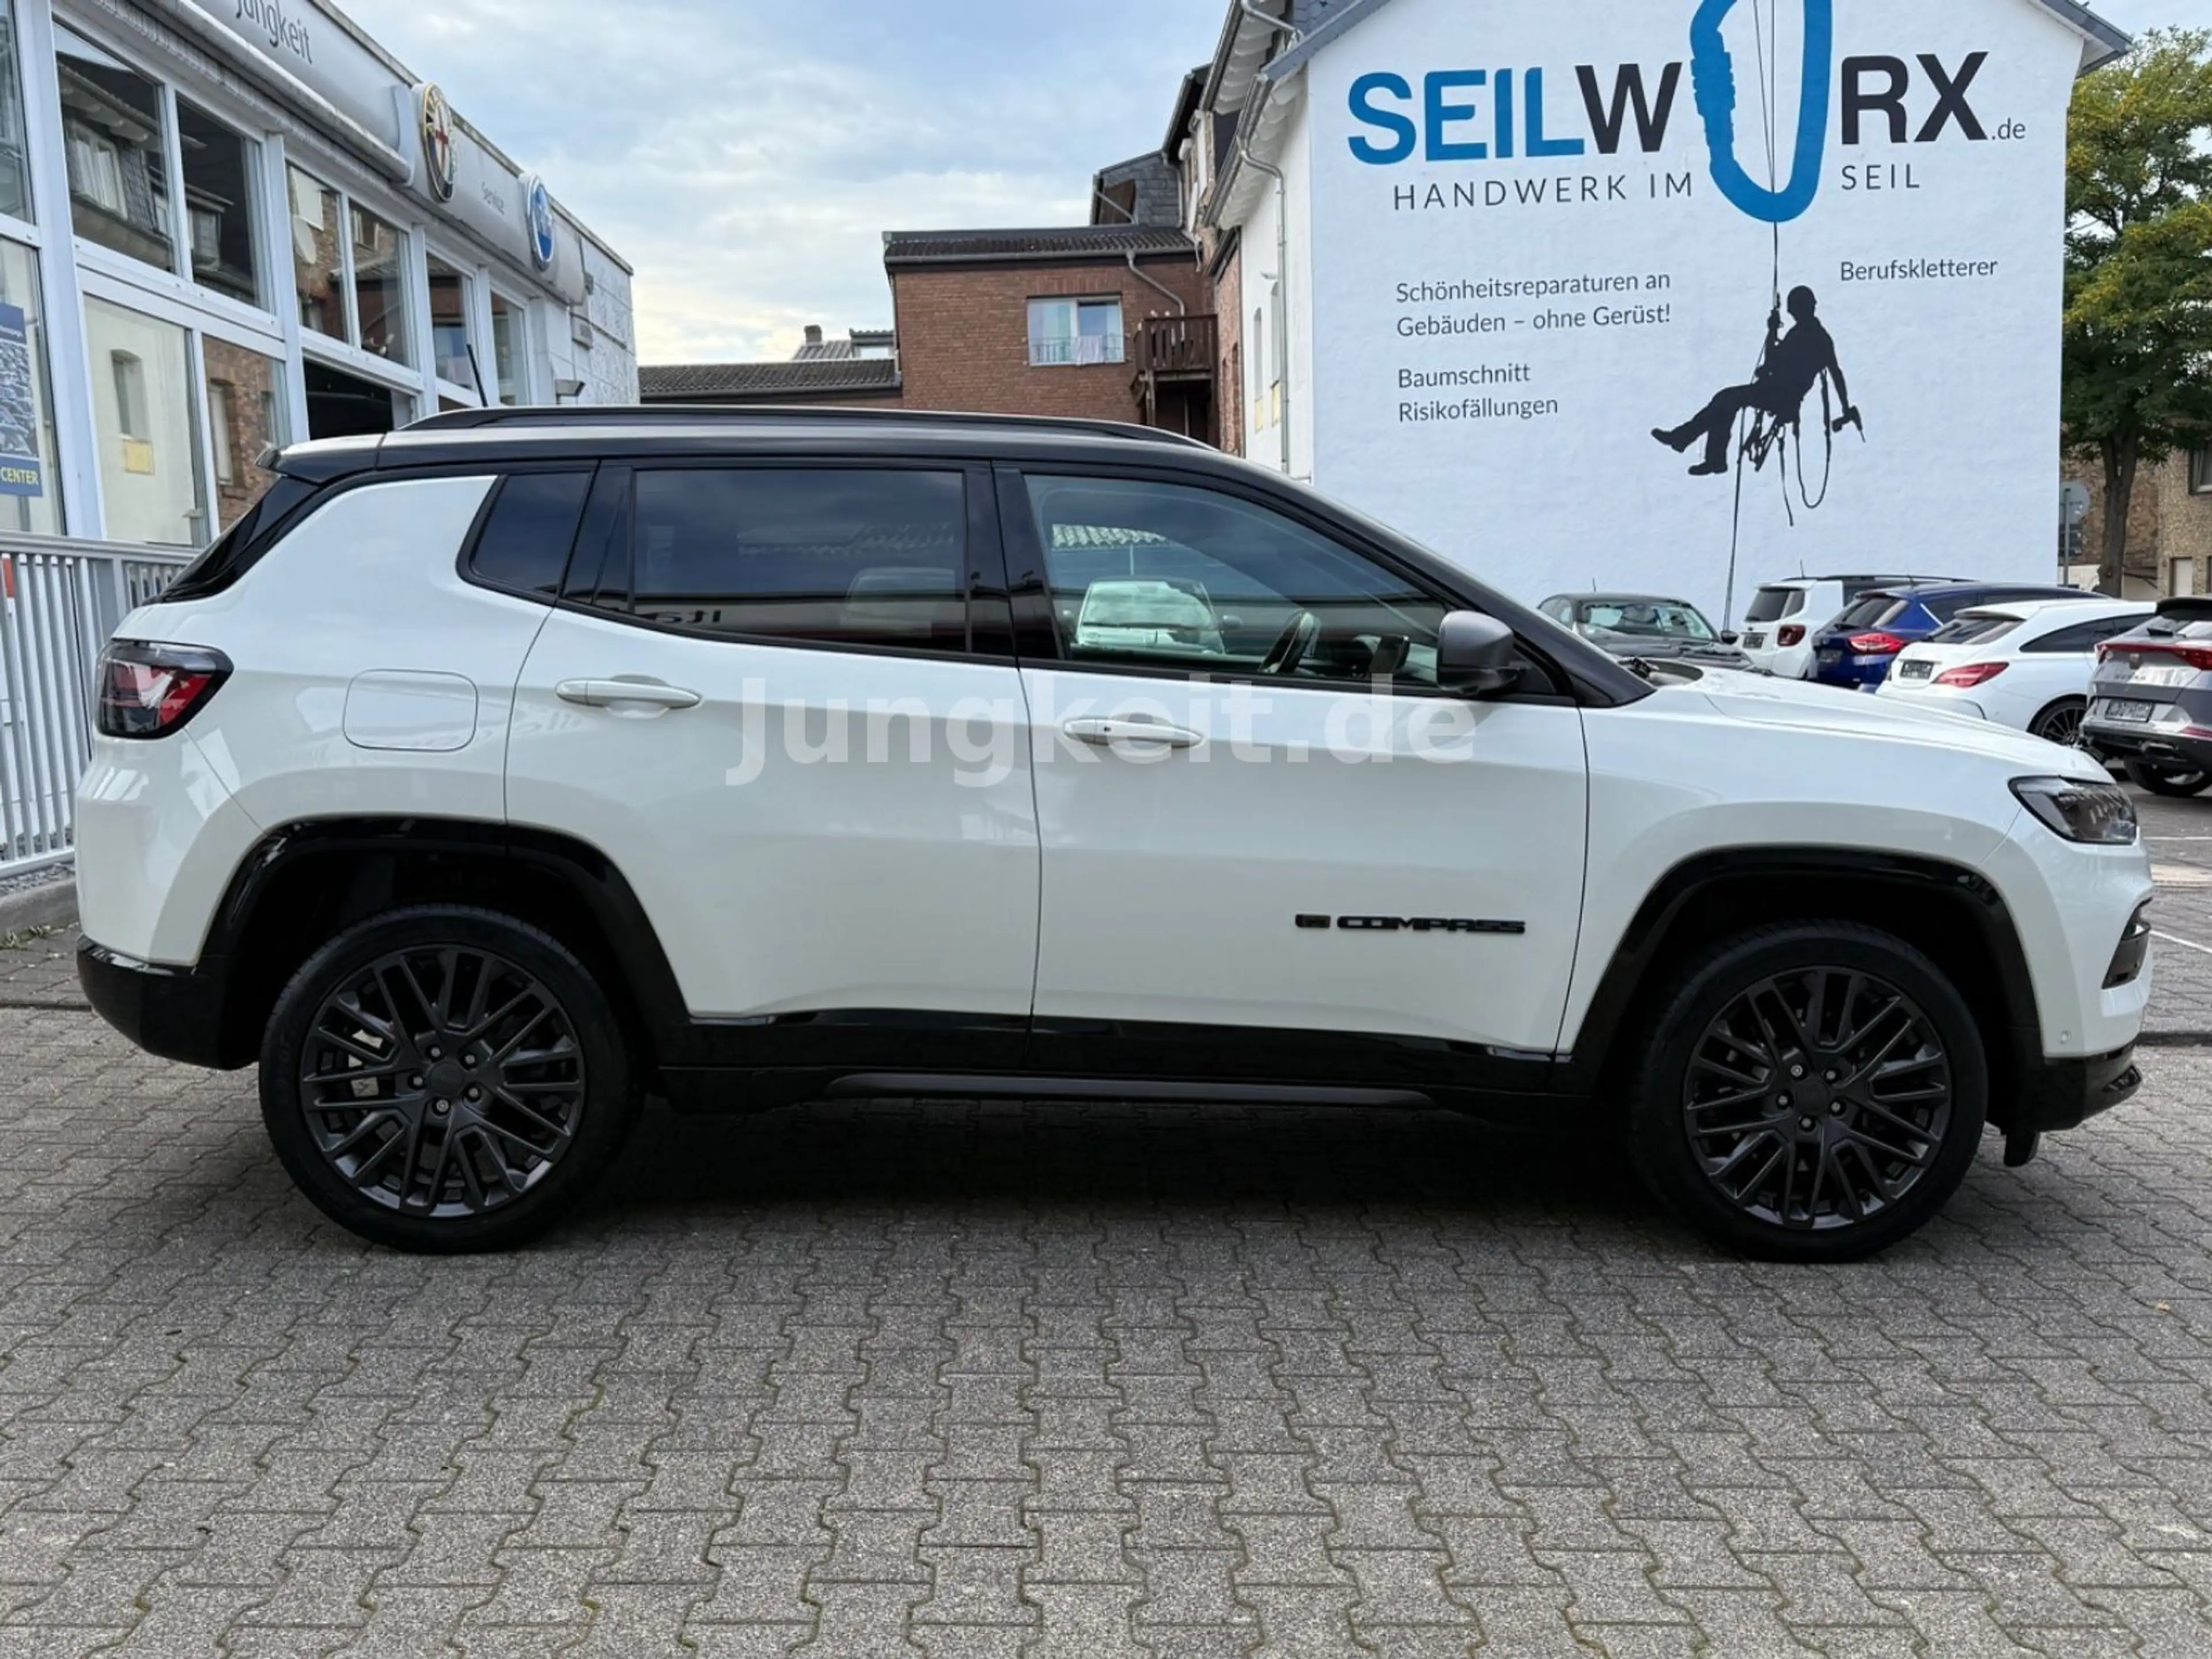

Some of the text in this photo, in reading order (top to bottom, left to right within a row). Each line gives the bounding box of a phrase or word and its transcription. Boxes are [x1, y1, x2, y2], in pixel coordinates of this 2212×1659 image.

[1393, 163, 1921, 211] HANDWERK IM SEIL
[1840, 258, 1999, 282] Berufskletterer
[1396, 273, 1671, 304] Schönheitsreparaturen an
[1396, 313, 1506, 337] Gebäuden
[1533, 308, 1586, 330] ohne
[1593, 303, 1671, 326] Gerüst!
[1398, 362, 1531, 389] Baumschnitt
[1399, 397, 1559, 423] Risikofällungen
